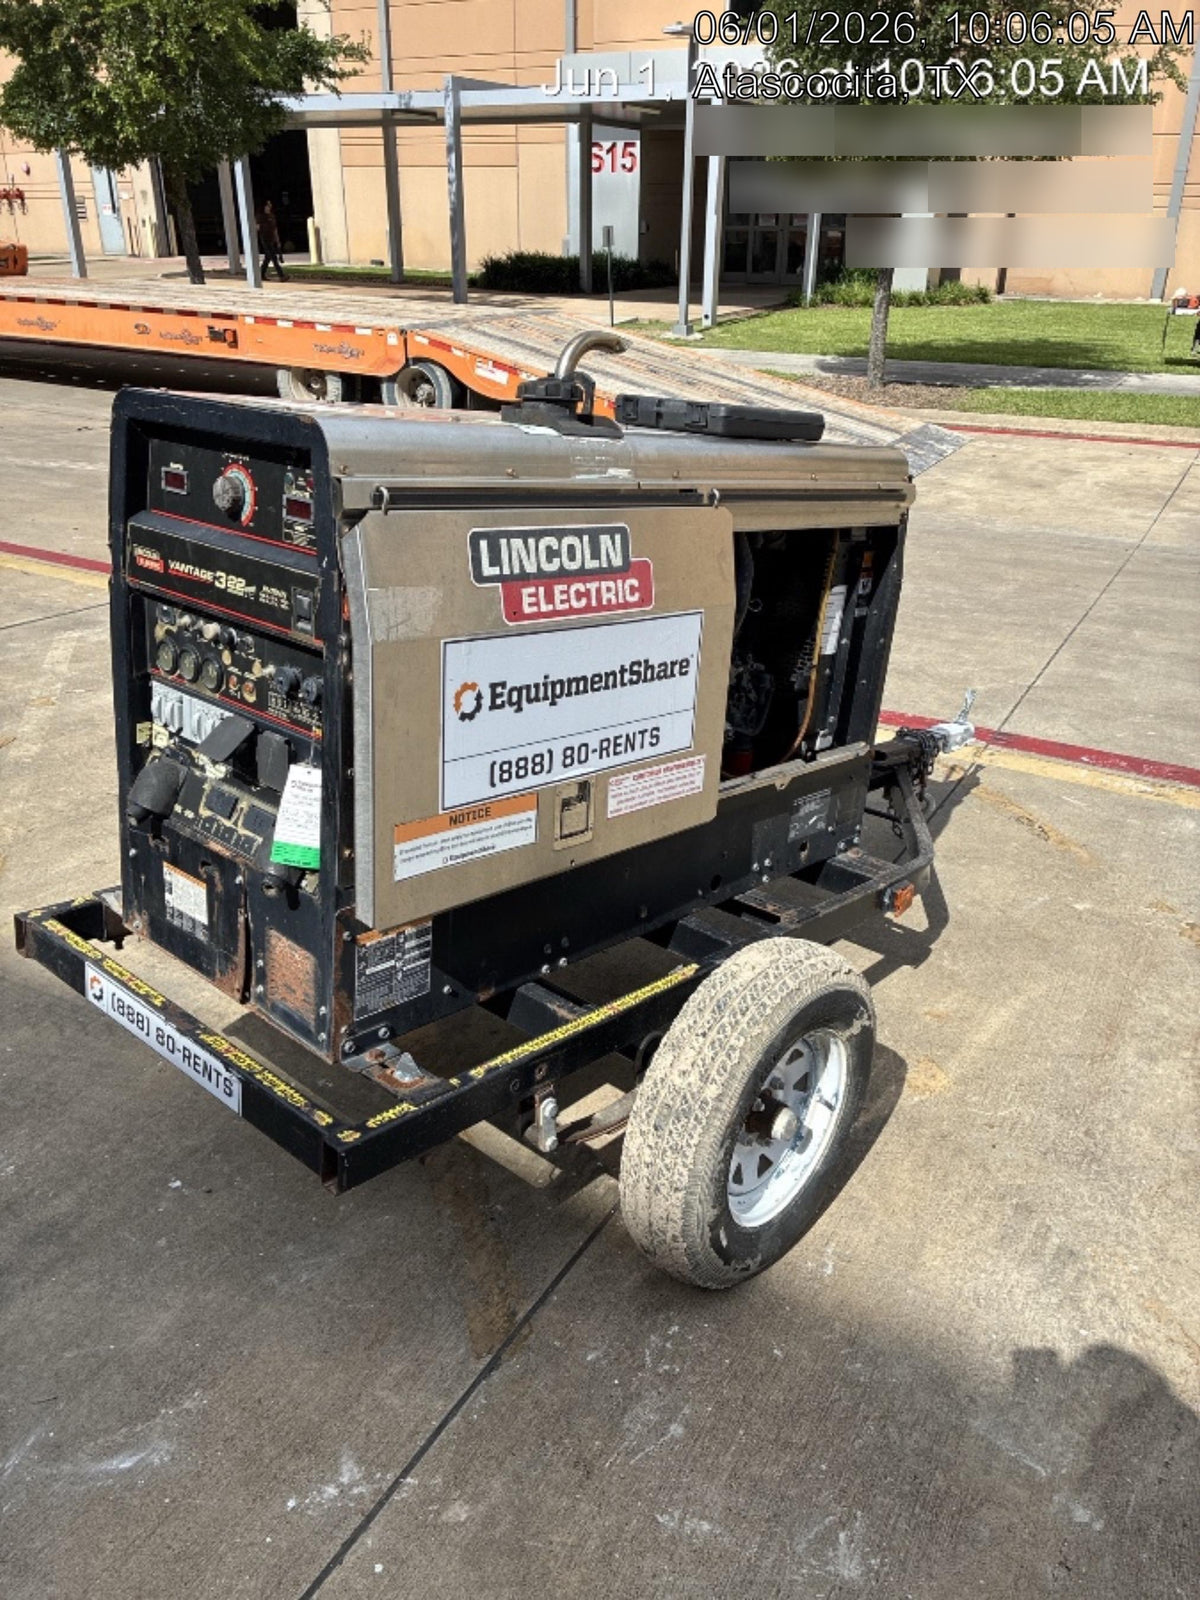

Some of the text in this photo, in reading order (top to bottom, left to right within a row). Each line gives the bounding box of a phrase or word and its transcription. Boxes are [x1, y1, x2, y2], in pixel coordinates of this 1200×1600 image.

[168, 559, 214, 582] VANTAGE
[479, 533, 623, 577] LINCOLN
[520, 578, 640, 614] ELECTRIC
[488, 656, 691, 713] EquipmentShare
[489, 726, 661, 788] (888) 80-RENTS
[448, 806, 492, 827] NOTICE
[111, 992, 150, 1038] (888)
[155, 1027, 234, 1098] 80-RENTS
